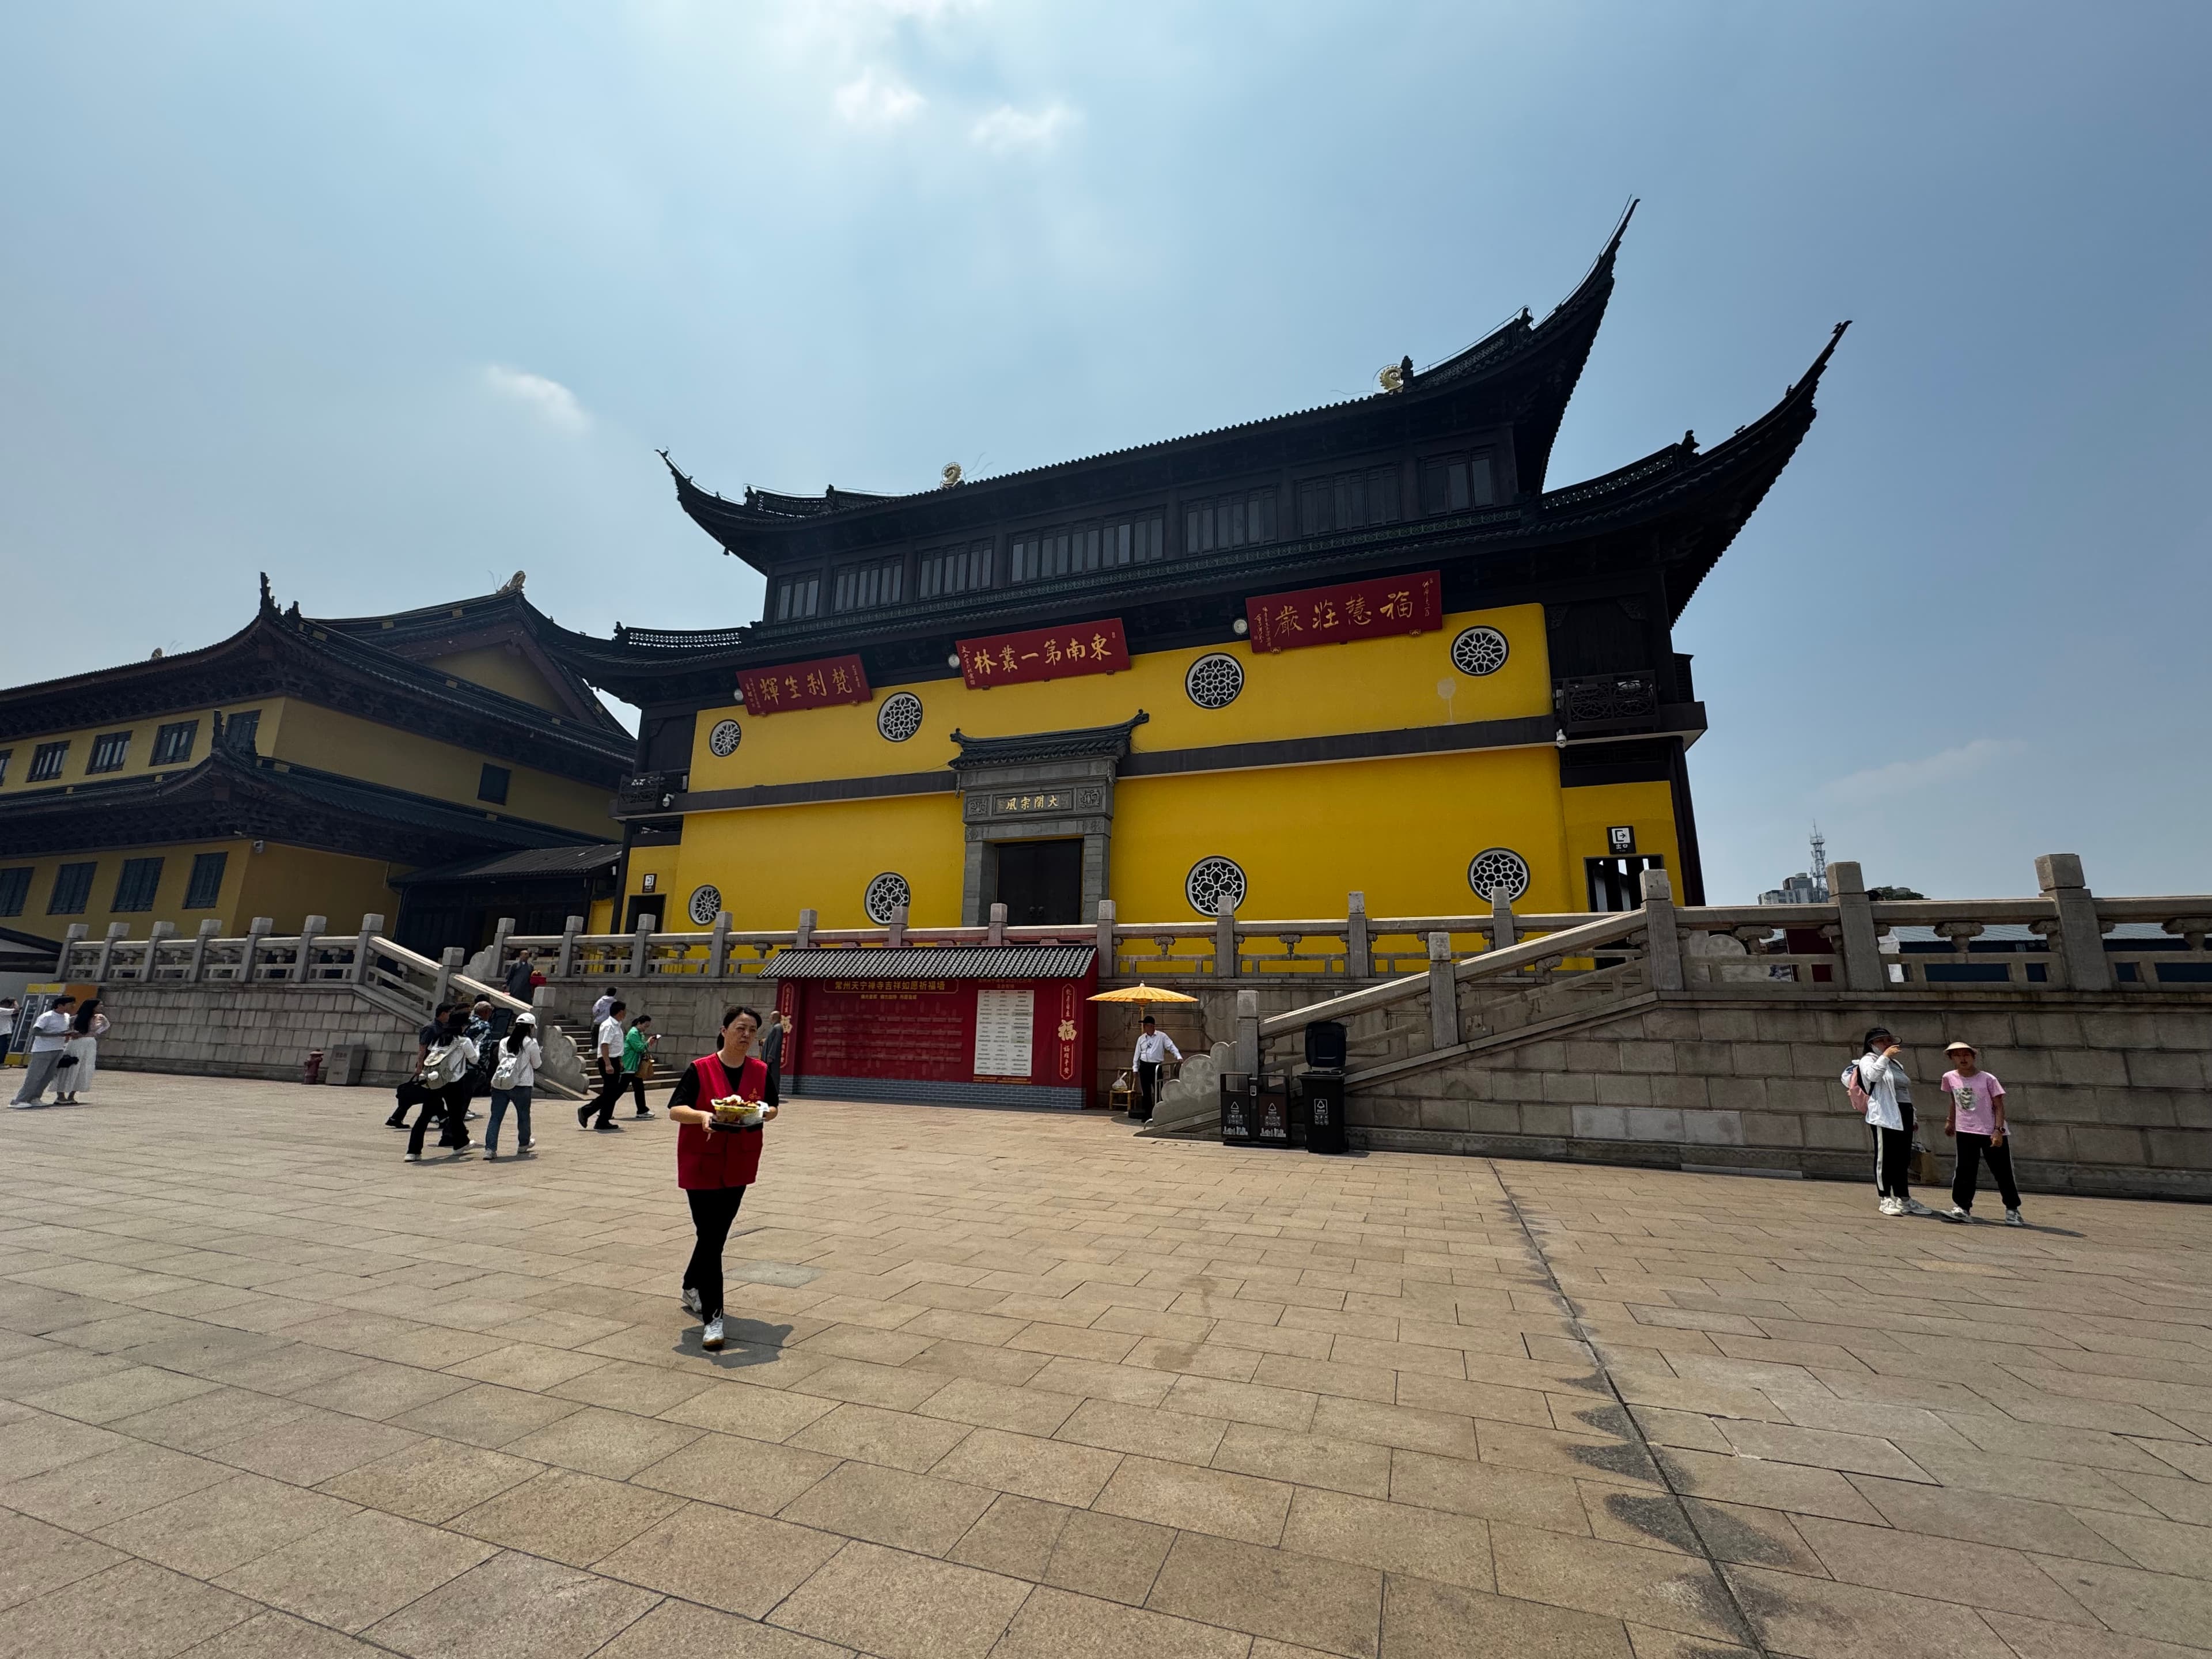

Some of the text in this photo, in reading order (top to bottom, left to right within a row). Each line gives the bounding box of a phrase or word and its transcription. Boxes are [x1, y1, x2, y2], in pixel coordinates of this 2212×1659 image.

[974, 632, 1112, 675] 東南第一叢林
[835, 980, 946, 991] 常州天宁禅寺吉祥如愿祈福墙
[1058, 1018, 1077, 1041] 福
